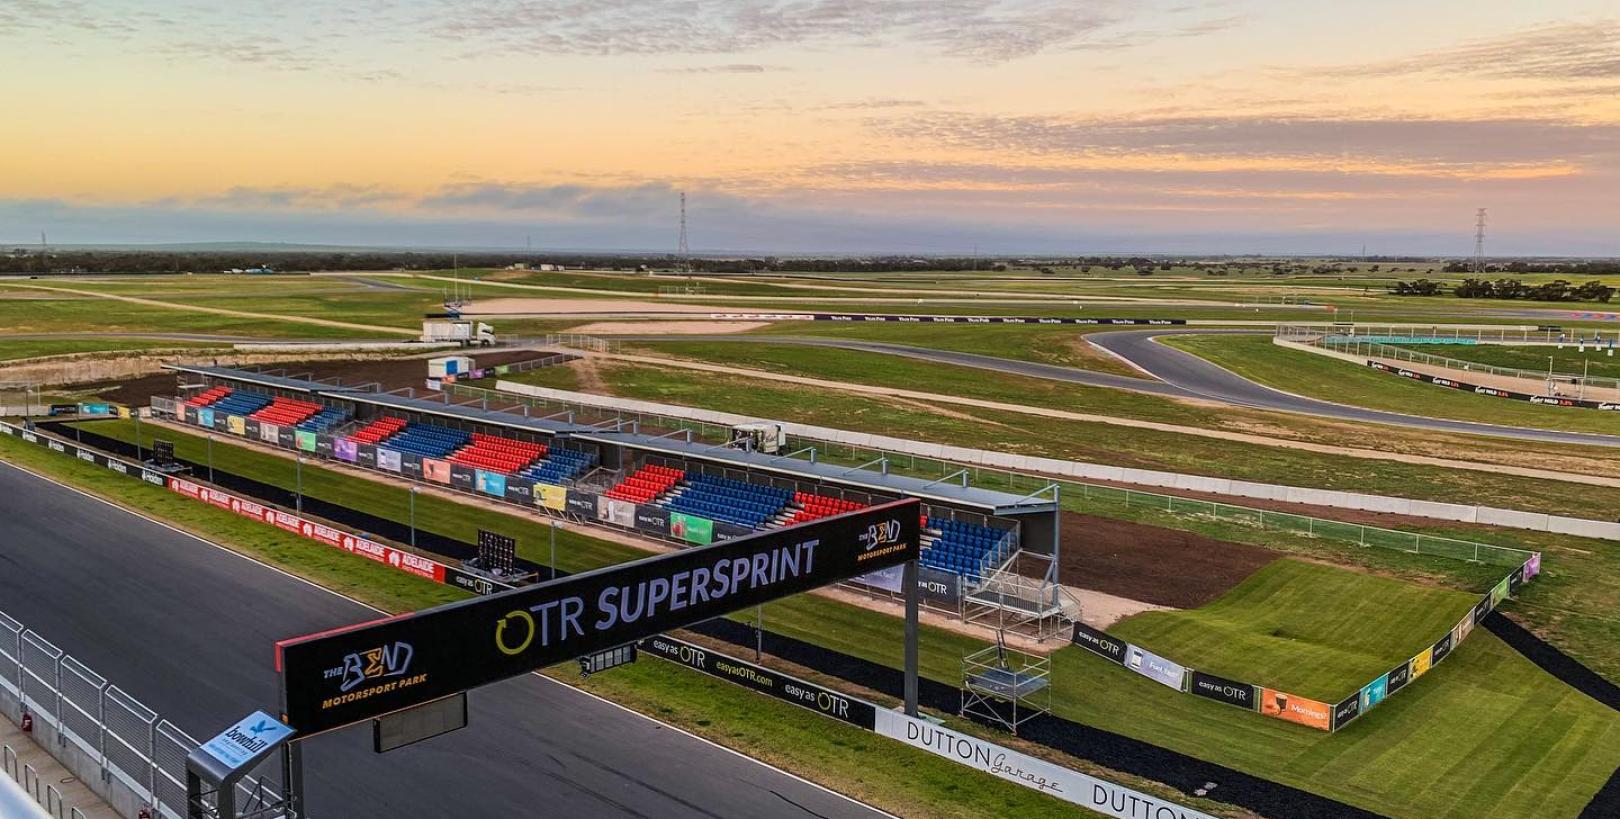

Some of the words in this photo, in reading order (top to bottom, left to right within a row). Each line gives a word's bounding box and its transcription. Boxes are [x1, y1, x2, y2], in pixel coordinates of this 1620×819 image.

[314, 523, 340, 541] ADELAIDE
[356, 539, 384, 557] ADELAIDE
[857, 546, 893, 562] MOTORSPORT
[403, 553, 434, 574] ADELAIDE
[474, 578, 493, 595] OTR
[495, 595, 585, 656] OTR
[594, 539, 820, 631] SUPERSPRINT
[928, 581, 947, 595] OTR
[653, 639, 671, 654] easy
[669, 645, 678, 656] as
[679, 645, 705, 669] OTR
[1078, 630, 1093, 642] easy
[1092, 637, 1099, 645] as
[1099, 639, 1121, 656] OTR
[323, 666, 344, 679] THE
[340, 641, 414, 692] BEND
[715, 660, 773, 688] easyasOTR.com
[322, 682, 398, 710] MOTORSPORT
[398, 673, 428, 689] PARK
[784, 683, 805, 701] easy
[804, 691, 815, 702] as
[817, 692, 849, 719] OTR
[1198, 681, 1215, 691] easy
[1214, 685, 1222, 693] as
[1222, 685, 1246, 701] OTR
[225, 725, 269, 754] bowhill
[907, 720, 991, 767] DUTTON
[991, 753, 1063, 790] Garage
